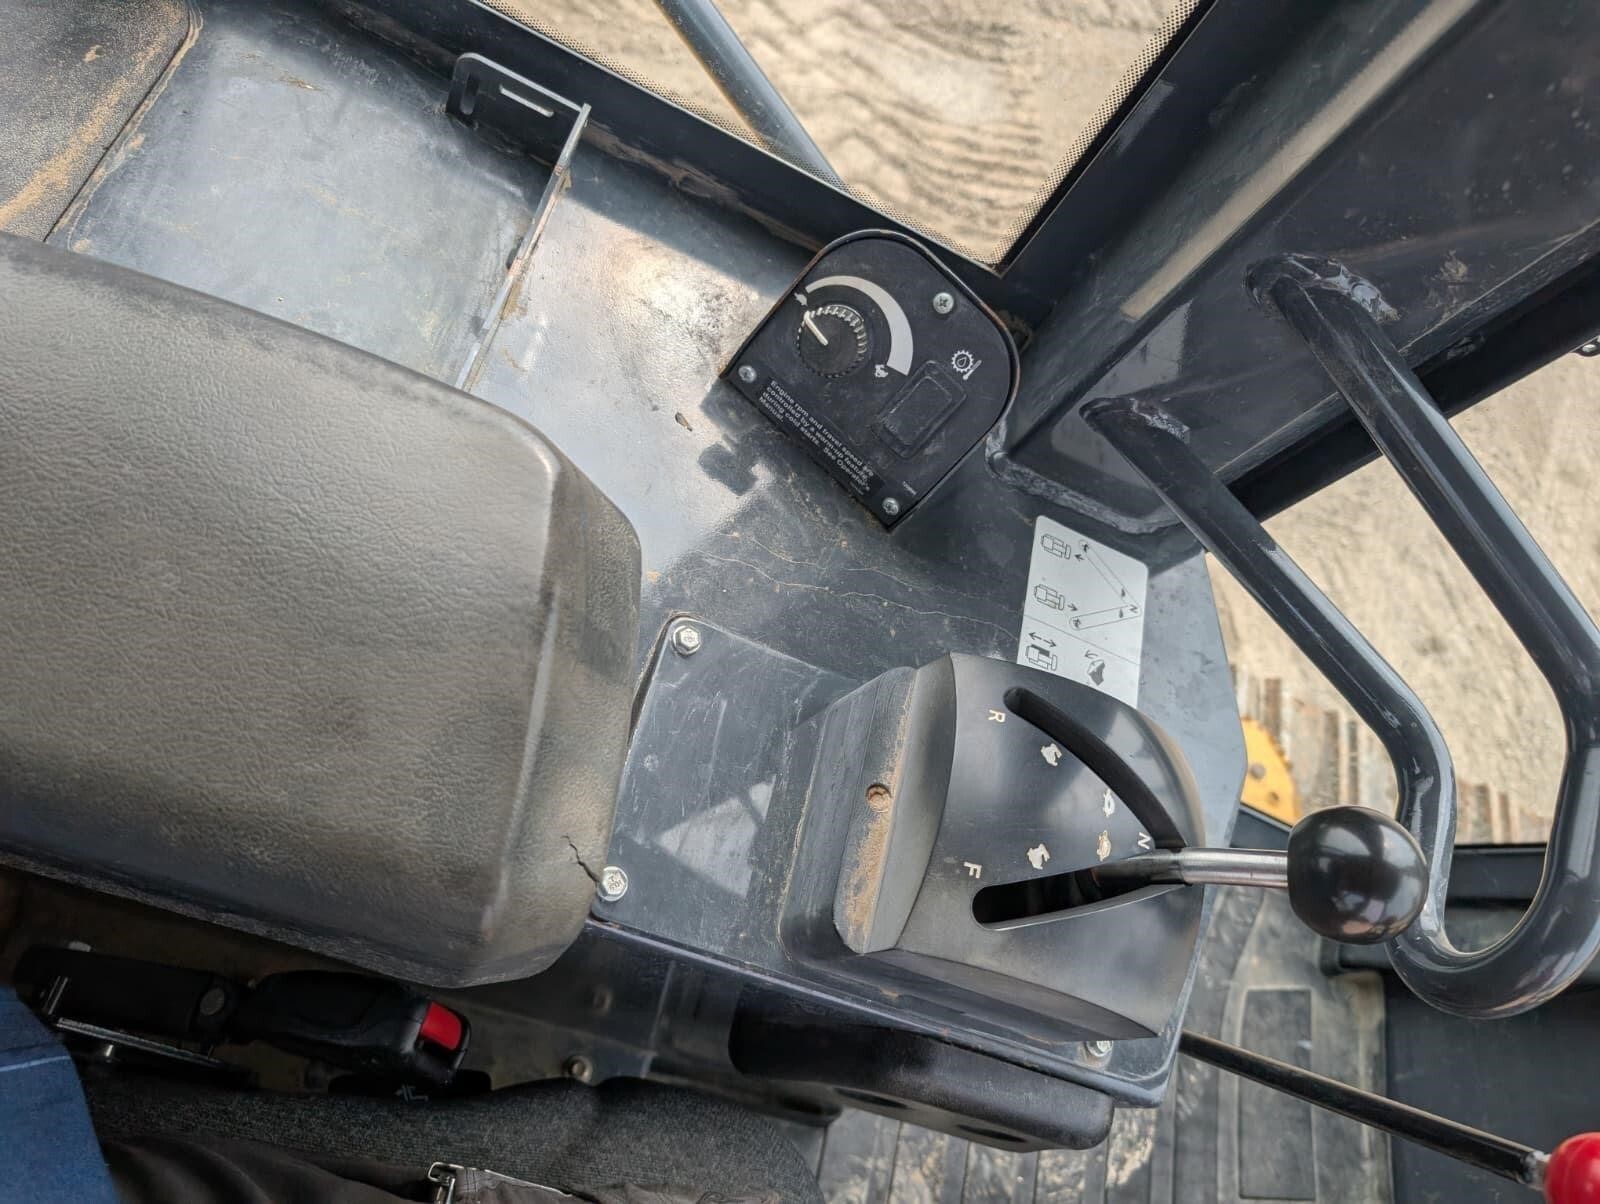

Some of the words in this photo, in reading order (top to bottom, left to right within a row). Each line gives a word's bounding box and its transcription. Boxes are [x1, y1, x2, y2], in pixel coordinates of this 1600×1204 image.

[759, 396, 783, 422] Manual.
[762, 391, 785, 414] during
[785, 412, 801, 427] cold
[823, 447, 837, 460] See
[766, 386, 801, 418] controlled
[800, 417, 810, 427] by
[815, 431, 844, 459] warm-up
[771, 380, 794, 404] Engine
[795, 403, 809, 417] rpm
[808, 416, 823, 430] and
[822, 428, 842, 447] travel
[841, 446, 862, 466] speed
[988, 709, 1006, 723] R
[1137, 831, 1151, 850] N
[963, 861, 983, 879] F
